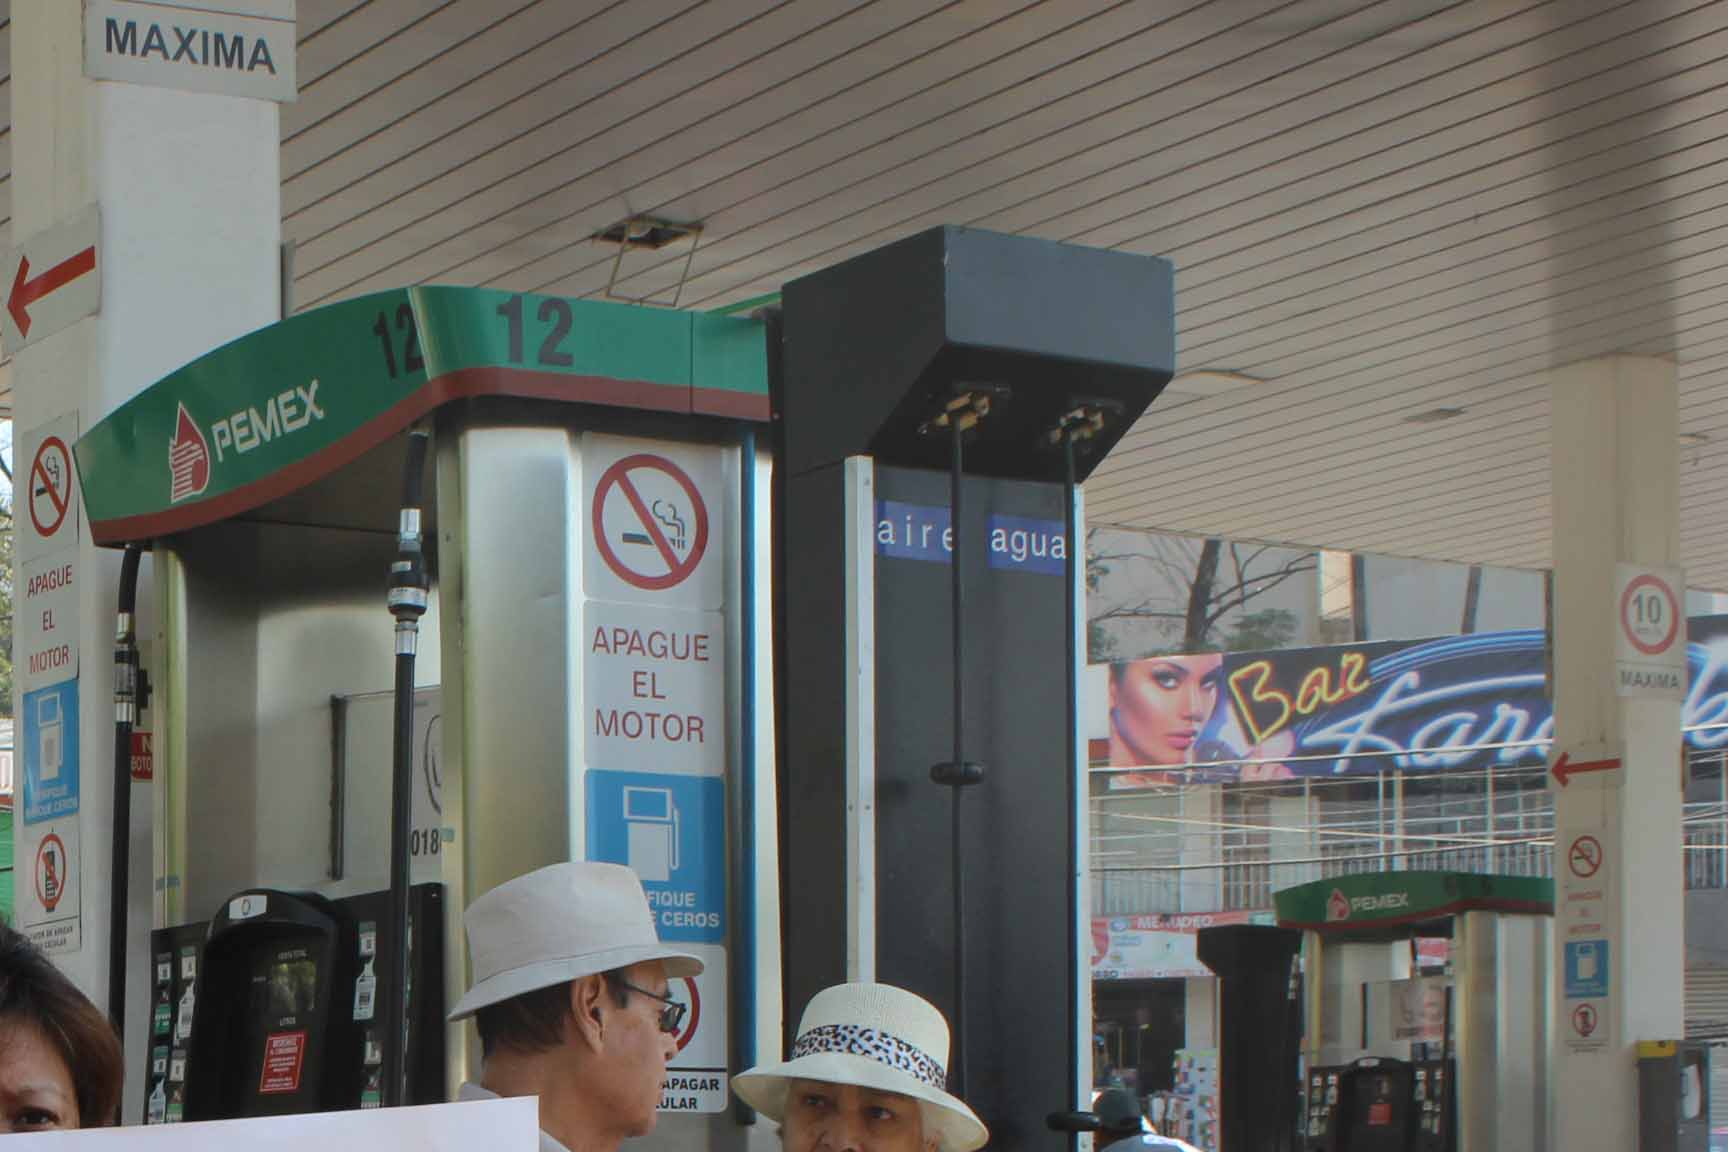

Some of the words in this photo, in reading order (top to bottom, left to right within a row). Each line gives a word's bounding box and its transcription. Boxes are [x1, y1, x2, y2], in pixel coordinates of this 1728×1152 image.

[105, 17, 277, 75] MAXIMA
[373, 303, 425, 379] 12
[495, 294, 575, 366] 12
[212, 380, 323, 462] PEMEX
[877, 515, 952, 551] aire
[991, 527, 1067, 562] agua
[27, 565, 73, 598] APAGUE
[43, 608, 55, 632] EL
[1633, 594, 1662, 624] 10
[29, 645, 69, 675] MOTOR
[592, 626, 710, 662] APAGUE
[633, 670, 666, 699] EL
[1621, 670, 1680, 689] MAXIMA
[1229, 652, 1371, 744] Bar
[595, 709, 704, 743] MOTOR
[662, 911, 720, 928] CEROS
[1351, 893, 1409, 913] PEMEX
[662, 1077, 720, 1092] APAGAR
